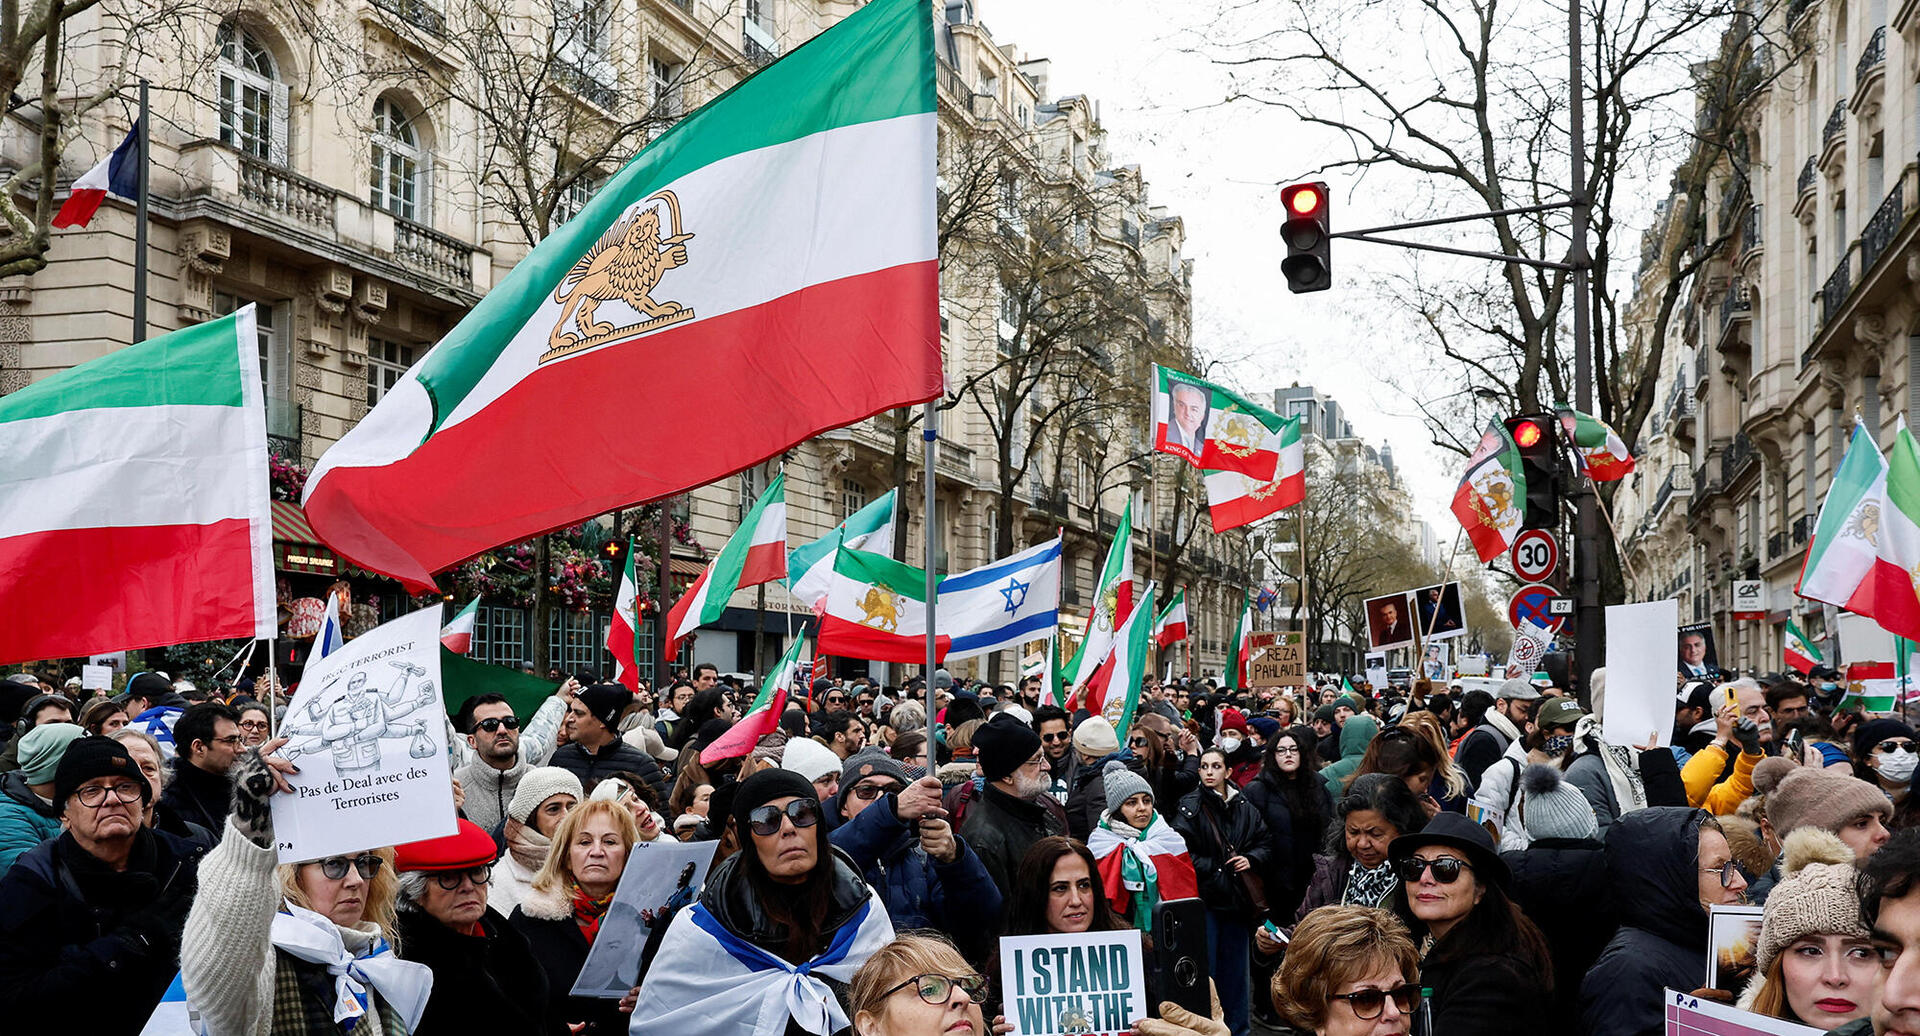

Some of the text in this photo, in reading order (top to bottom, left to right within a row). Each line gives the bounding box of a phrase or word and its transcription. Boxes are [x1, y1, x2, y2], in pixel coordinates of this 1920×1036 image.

[1165, 445, 1182, 454] KING
[1520, 543, 1549, 568] 30
[1738, 583, 1761, 598] CA
[751, 600, 815, 614] RSTORANTE
[1555, 602, 1568, 611] 87
[1275, 634, 1287, 646] LE
[350, 640, 416, 669] TERRORIST
[1266, 647, 1298, 662] REZA
[1254, 663, 1294, 681] PAHLAVI
[299, 766, 428, 799] Pas de Deal avec des
[331, 790, 400, 811] Terroristes
[1014, 943, 1130, 996] I STAND
[1088, 992, 1134, 1032] THE
